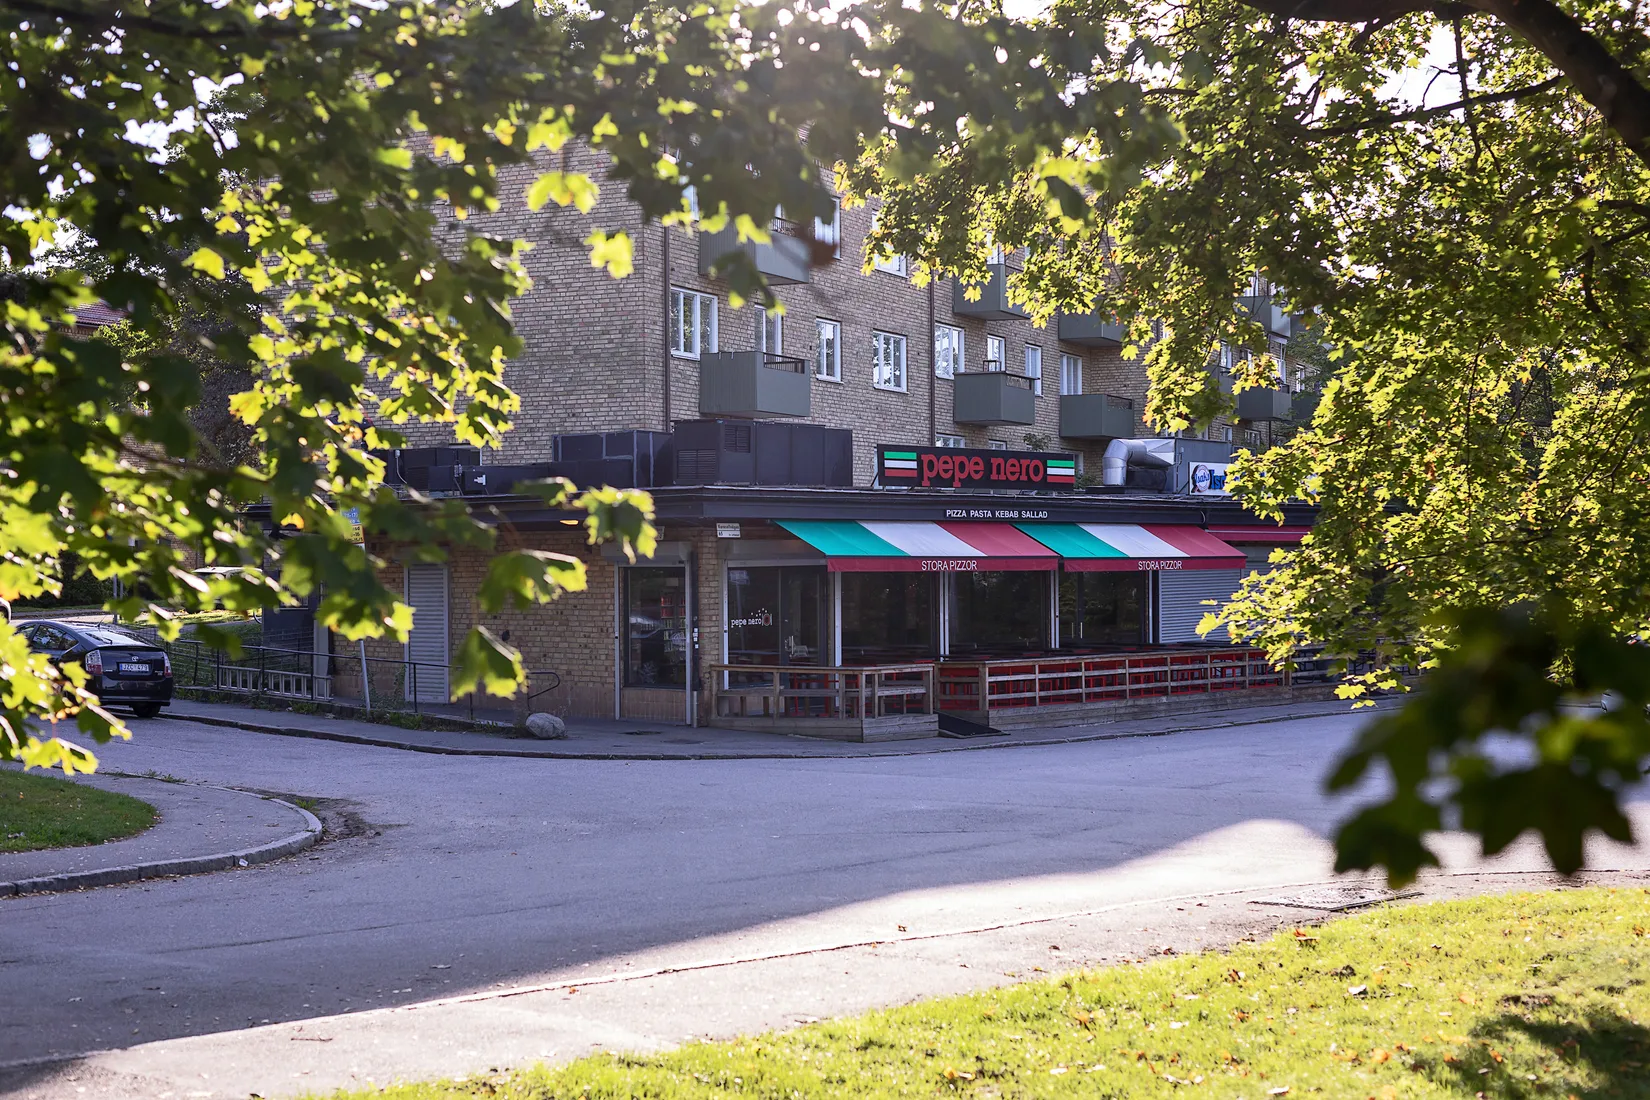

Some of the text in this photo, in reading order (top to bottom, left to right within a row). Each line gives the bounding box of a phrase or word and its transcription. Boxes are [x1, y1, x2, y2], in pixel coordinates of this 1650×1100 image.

[921, 454, 1044, 487] pepe nero
[946, 509, 1048, 519] PIZZA PASTA KEBAB SALLAD
[921, 560, 978, 571] STORA PIZZOR
[1138, 560, 1183, 571] STORA PIZZOR
[730, 619, 747, 628] pepe
